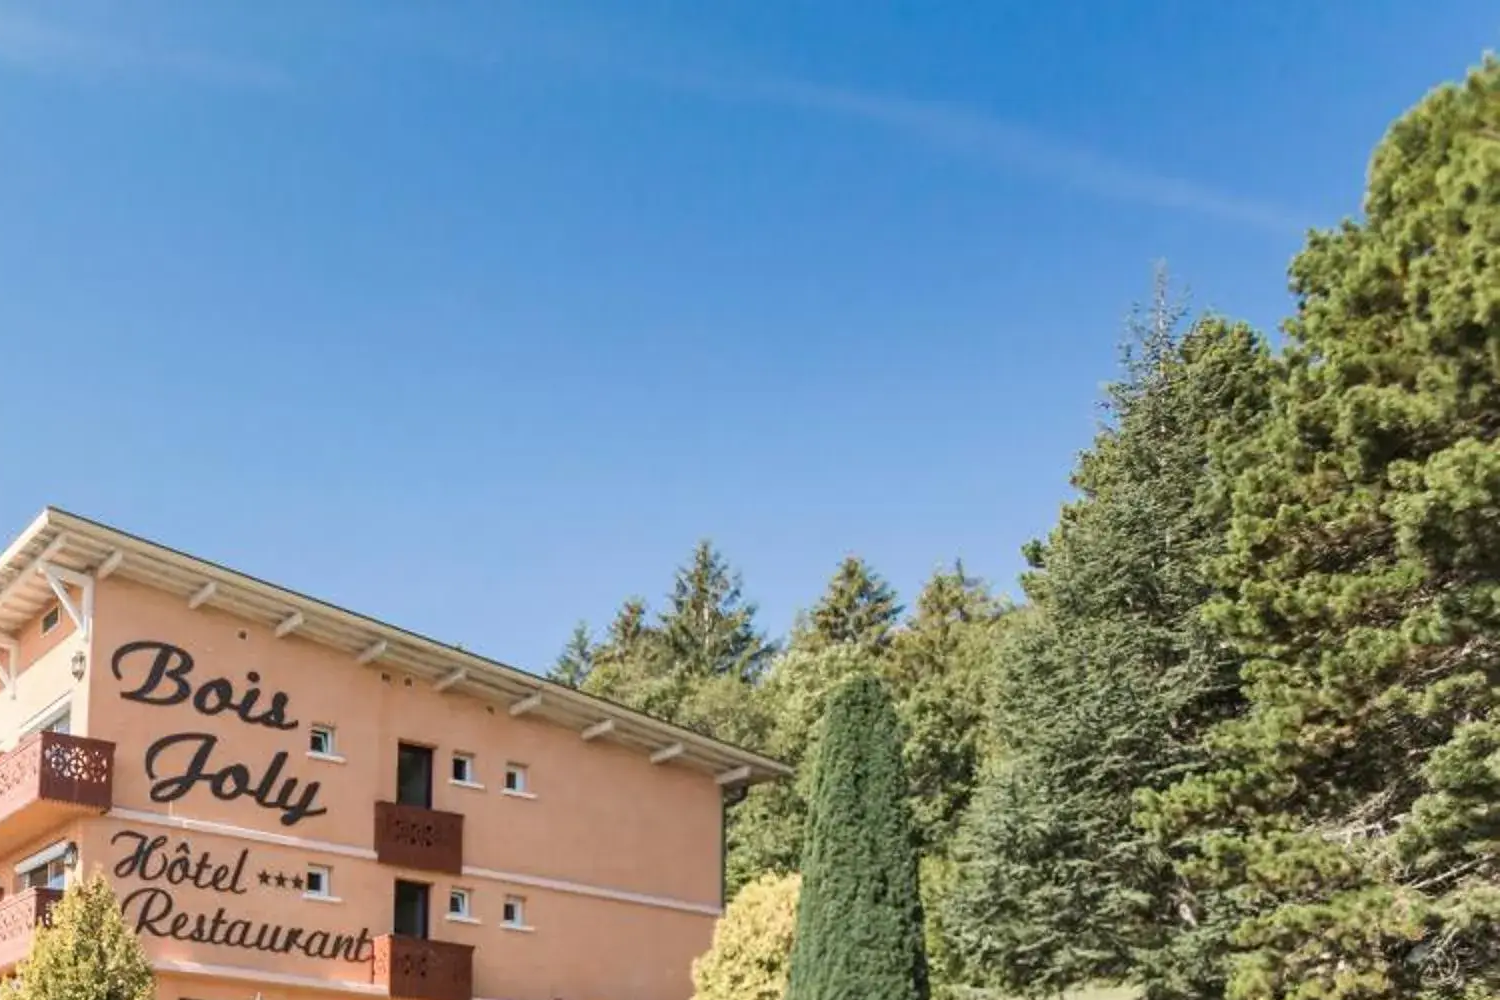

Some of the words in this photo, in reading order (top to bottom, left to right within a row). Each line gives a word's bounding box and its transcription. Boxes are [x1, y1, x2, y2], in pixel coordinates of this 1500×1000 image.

[110, 640, 299, 731] Bois
[145, 731, 328, 826] Joly
[110, 829, 248, 895] Hôtel
[120, 887, 376, 963] Restaurant
